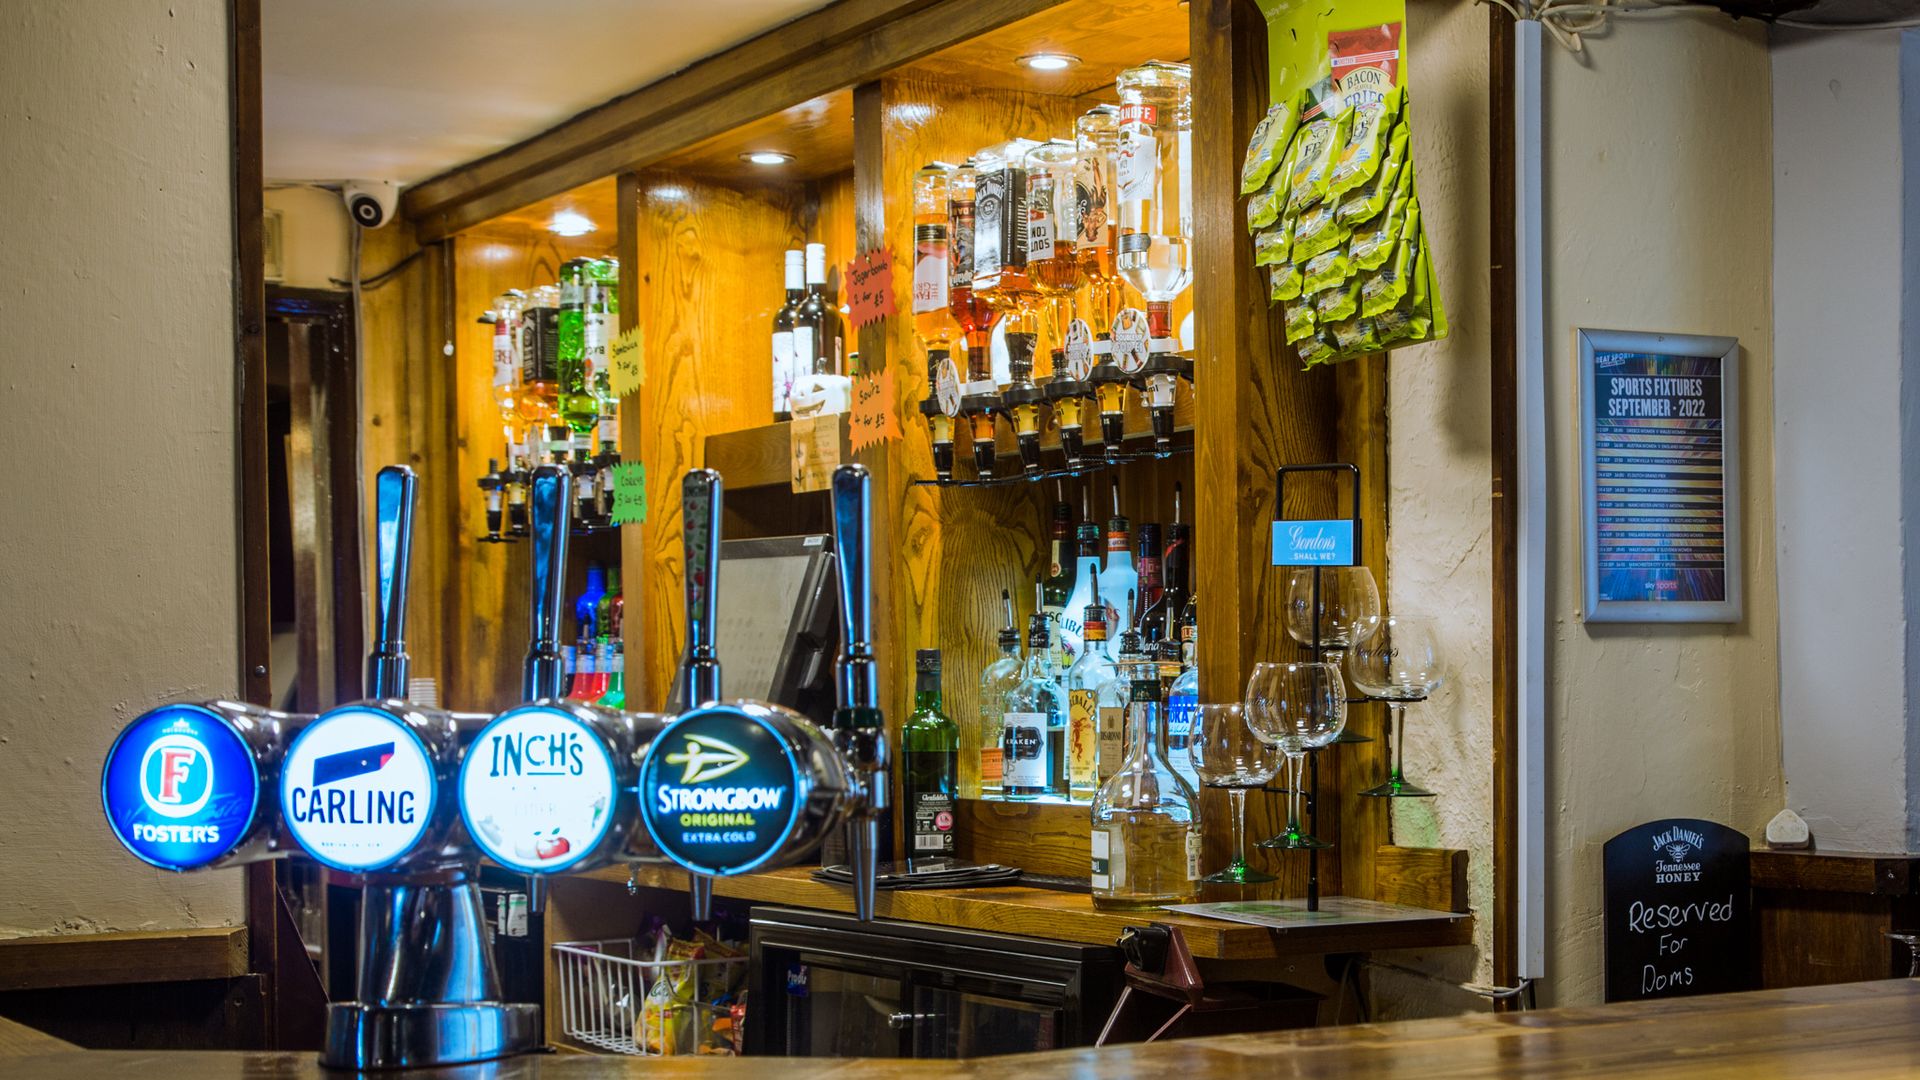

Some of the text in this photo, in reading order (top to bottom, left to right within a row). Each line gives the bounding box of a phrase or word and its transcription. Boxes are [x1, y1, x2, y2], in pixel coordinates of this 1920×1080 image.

[1347, 71, 1381, 89] BACON
[1611, 377, 1703, 397] SPORTS FIXTURES
[1608, 398, 1706, 417] SEPTEMBER 2022
[1289, 525, 1336, 551] Gordon's
[1294, 552, 1336, 560] SHALL WE?
[1645, 581, 1677, 590] sky sports
[490, 732, 583, 777] INCH'S
[292, 787, 415, 825] CARLING
[658, 784, 781, 813] STRONGBOW
[680, 812, 756, 827] ORIGINAL
[132, 823, 219, 843] FOSTER'S
[682, 830, 757, 844] EXTRA COLD
[1652, 826, 1704, 851] JACK DANIEL'S
[1655, 859, 1701, 873] Tennessee
[1655, 872, 1701, 884] HONEY
[1628, 894, 1733, 934] Reserved
[1659, 933, 1688, 956] For
[1641, 964, 1694, 995] Doms
